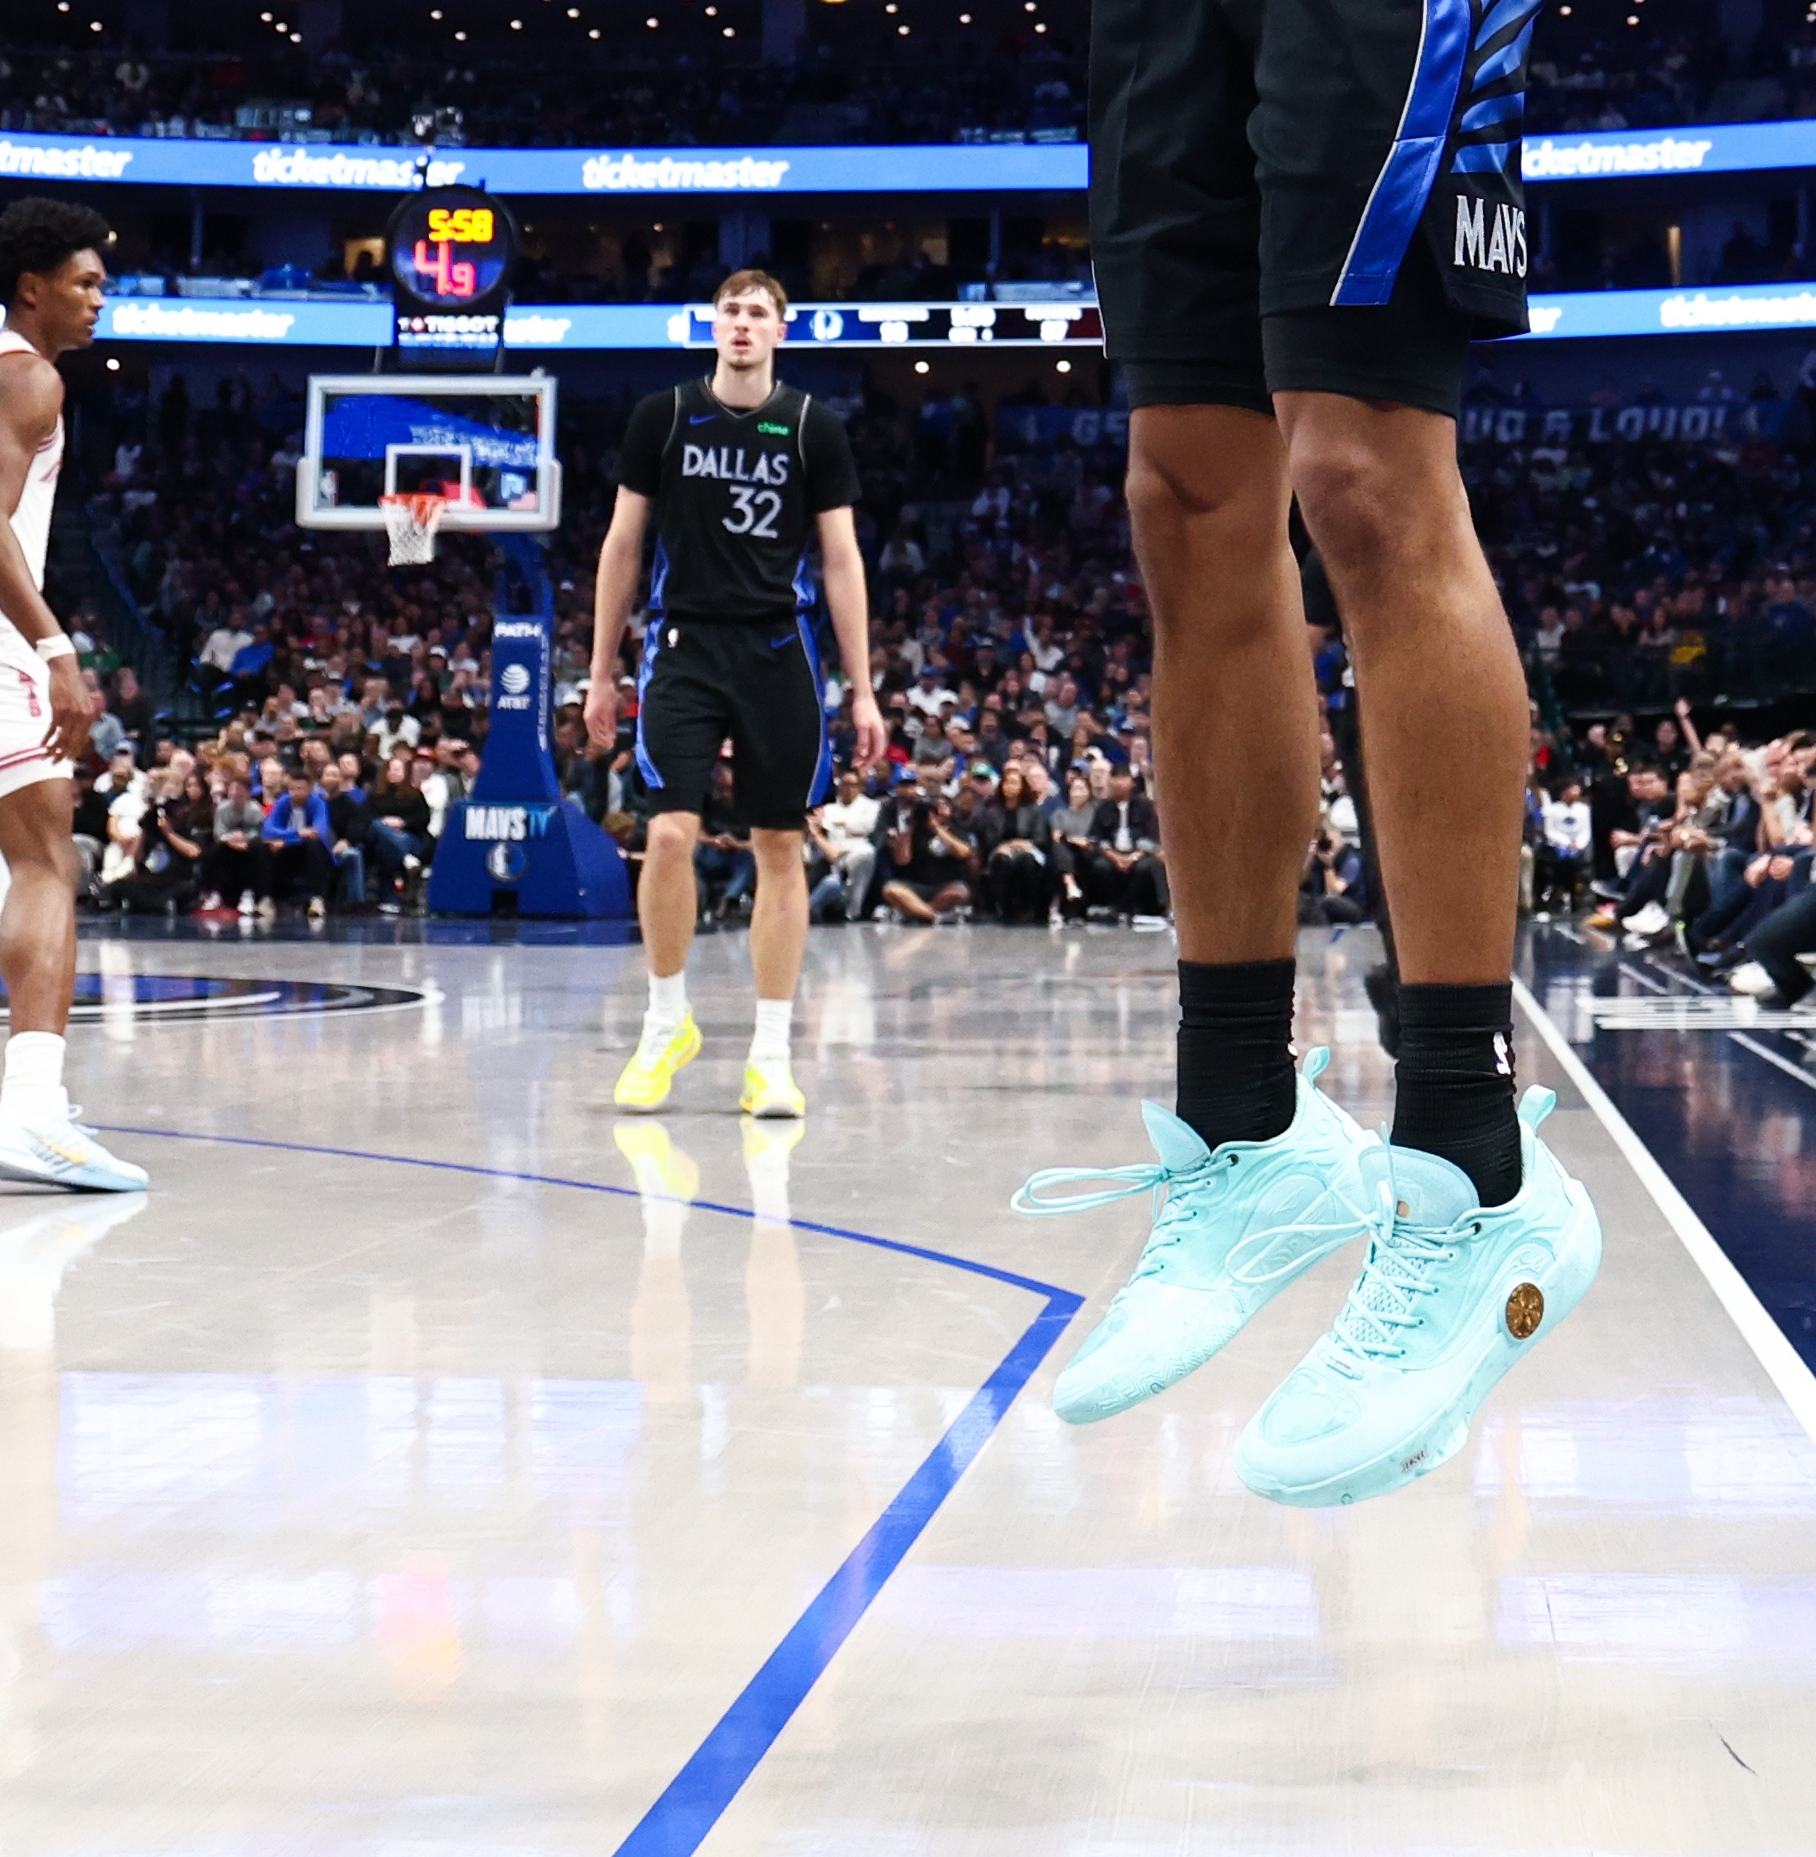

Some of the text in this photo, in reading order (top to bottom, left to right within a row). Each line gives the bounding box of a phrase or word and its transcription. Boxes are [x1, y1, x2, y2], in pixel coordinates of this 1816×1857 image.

[582, 154, 790, 189] ticketmaster
[1523, 138, 1713, 178] icketmaster
[428, 208, 494, 244] 5:58
[1453, 194, 1528, 279] MAVS
[112, 302, 295, 339] ticketmaster
[424, 315, 500, 333] TISSOT
[683, 444, 789, 485] DALLAS
[722, 484, 780, 538] 32
